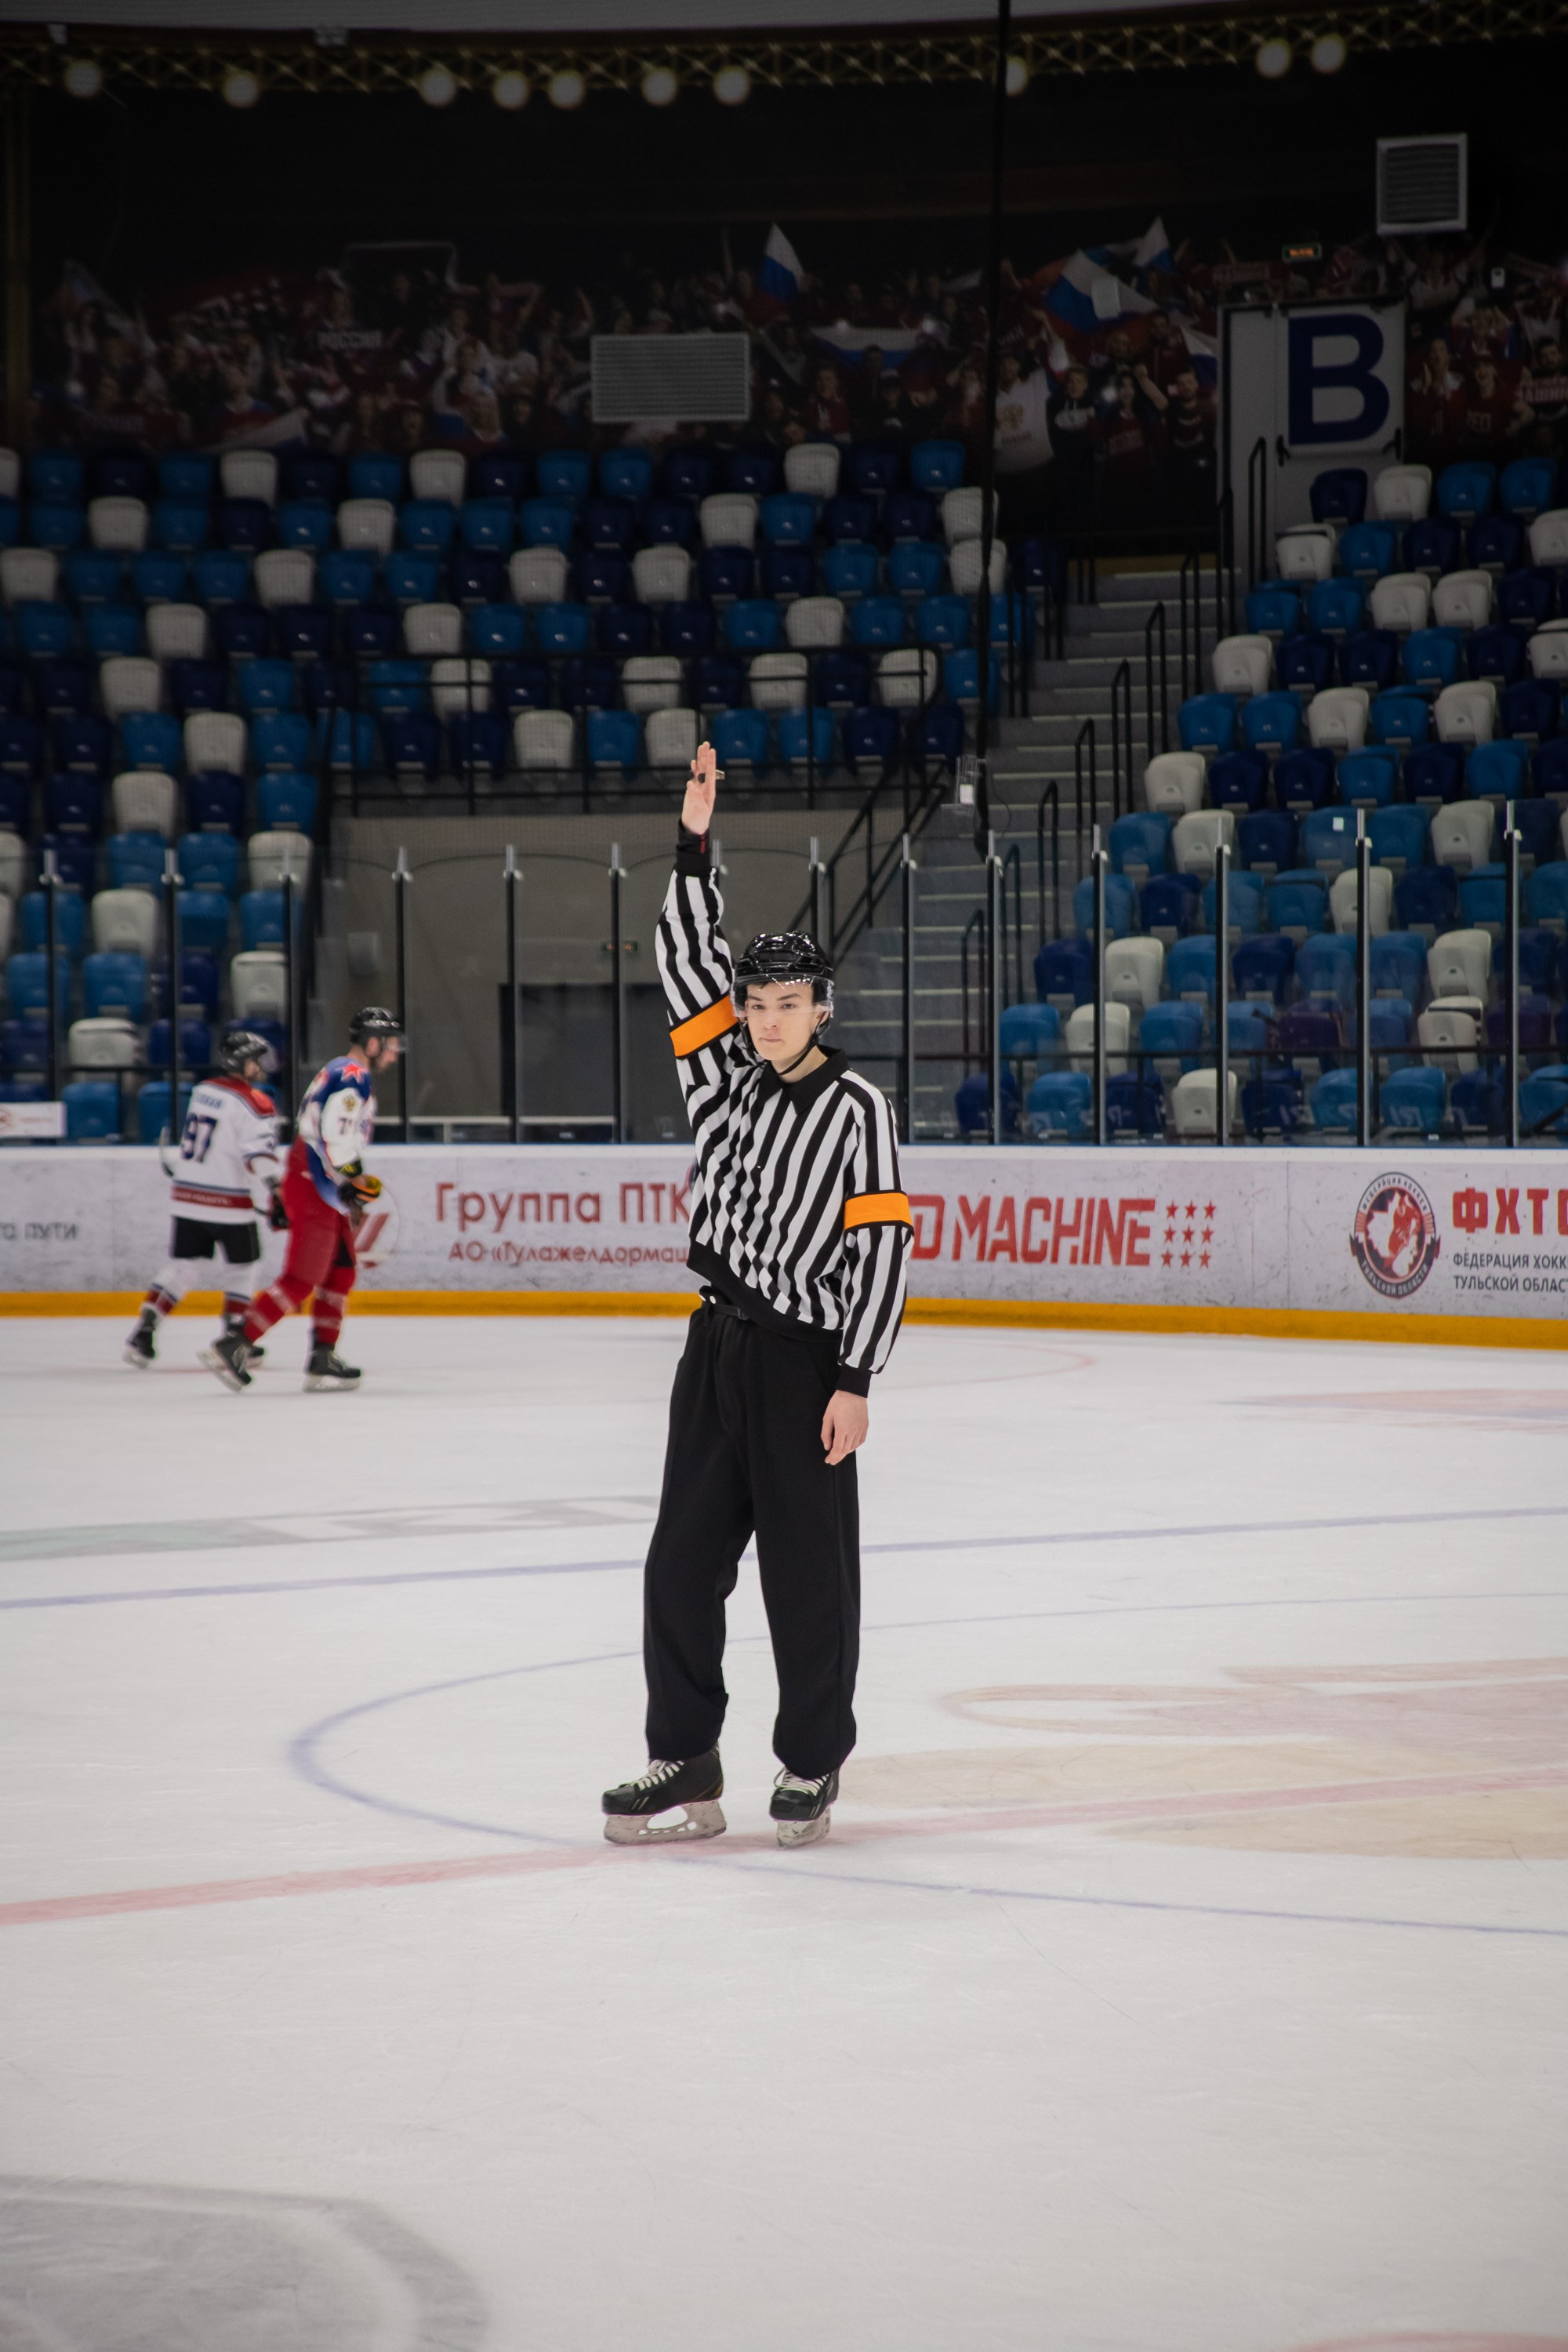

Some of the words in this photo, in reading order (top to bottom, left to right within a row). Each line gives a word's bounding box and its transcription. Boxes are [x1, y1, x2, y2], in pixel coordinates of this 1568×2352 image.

[436, 1182, 601, 1232] Группа
[619, 1182, 690, 1223] ПТК
[907, 1194, 946, 1260] D
[950, 1195, 1156, 1267] MACHINE
[448, 1240, 484, 1262] АО
[1453, 1253, 1529, 1271] ФЕДЕРАЦИЯ
[1534, 1254, 1568, 1269] ХОКК
[1454, 1275, 1519, 1292] ТУЛЬСКОЙ
